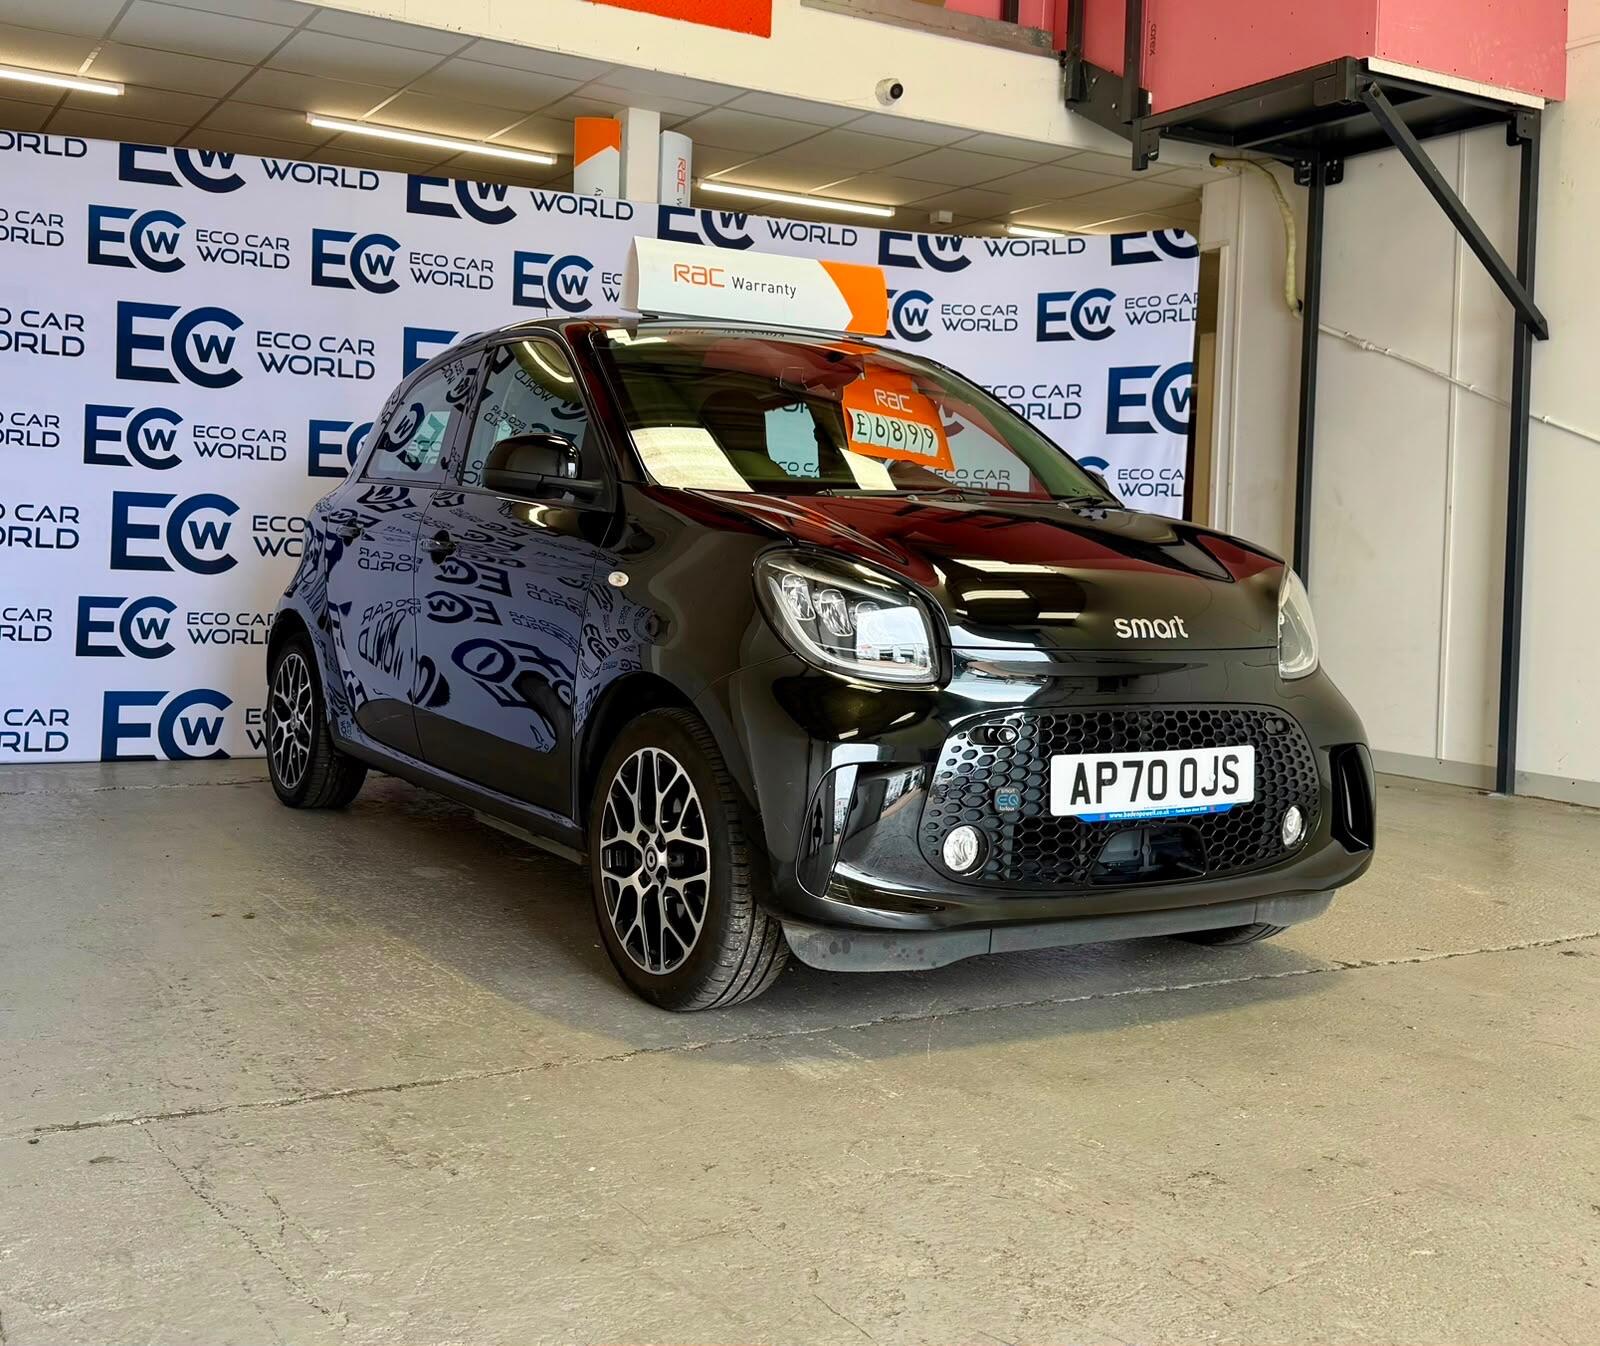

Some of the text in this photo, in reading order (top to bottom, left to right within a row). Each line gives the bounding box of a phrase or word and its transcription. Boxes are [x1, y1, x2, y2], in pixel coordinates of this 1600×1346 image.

[0, 131, 87, 157] ORLD
[261, 159, 379, 190] WORLD
[530, 191, 634, 221] WORLD
[15, 211, 64, 228] CAR
[0, 225, 64, 247] RLD
[196, 229, 290, 251] ECO CAR
[766, 220, 858, 247] WORLD
[197, 245, 290, 270] WORLD
[984, 238, 1086, 257] WORLD
[410, 252, 494, 273] ECO CAR
[410, 267, 494, 290] WORLD
[602, 272, 622, 286] EC
[731, 276, 797, 299] Warranty
[941, 304, 1018, 316] ECO CAR
[1125, 295, 1162, 309] ECO
[20, 310, 85, 332] CAR
[941, 318, 1018, 332] WORLD
[257, 331, 375, 357] ECO CAR
[257, 351, 376, 380] WORLD
[1032, 383, 1082, 399] CAR
[11, 412, 60, 428] CAR
[0, 428, 60, 448] RLD
[193, 425, 287, 443] ECO CAR
[857, 413, 935, 449] £6899
[194, 441, 287, 462] WORLD
[973, 469, 1010, 480] CAR
[1118, 468, 1184, 480] ECO CA
[1118, 482, 1184, 497] WORL
[14, 503, 80, 524] CAR
[252, 515, 305, 533] ECO
[0, 525, 80, 550] RLD
[2, 607, 53, 622] CAR
[187, 612, 230, 625] ECO
[0, 624, 53, 642] RLD
[1114, 615, 1189, 639] smart
[4, 708, 70, 727] CAR
[0, 731, 69, 752] RLD
[1070, 754, 1239, 806] AP70 OJS
